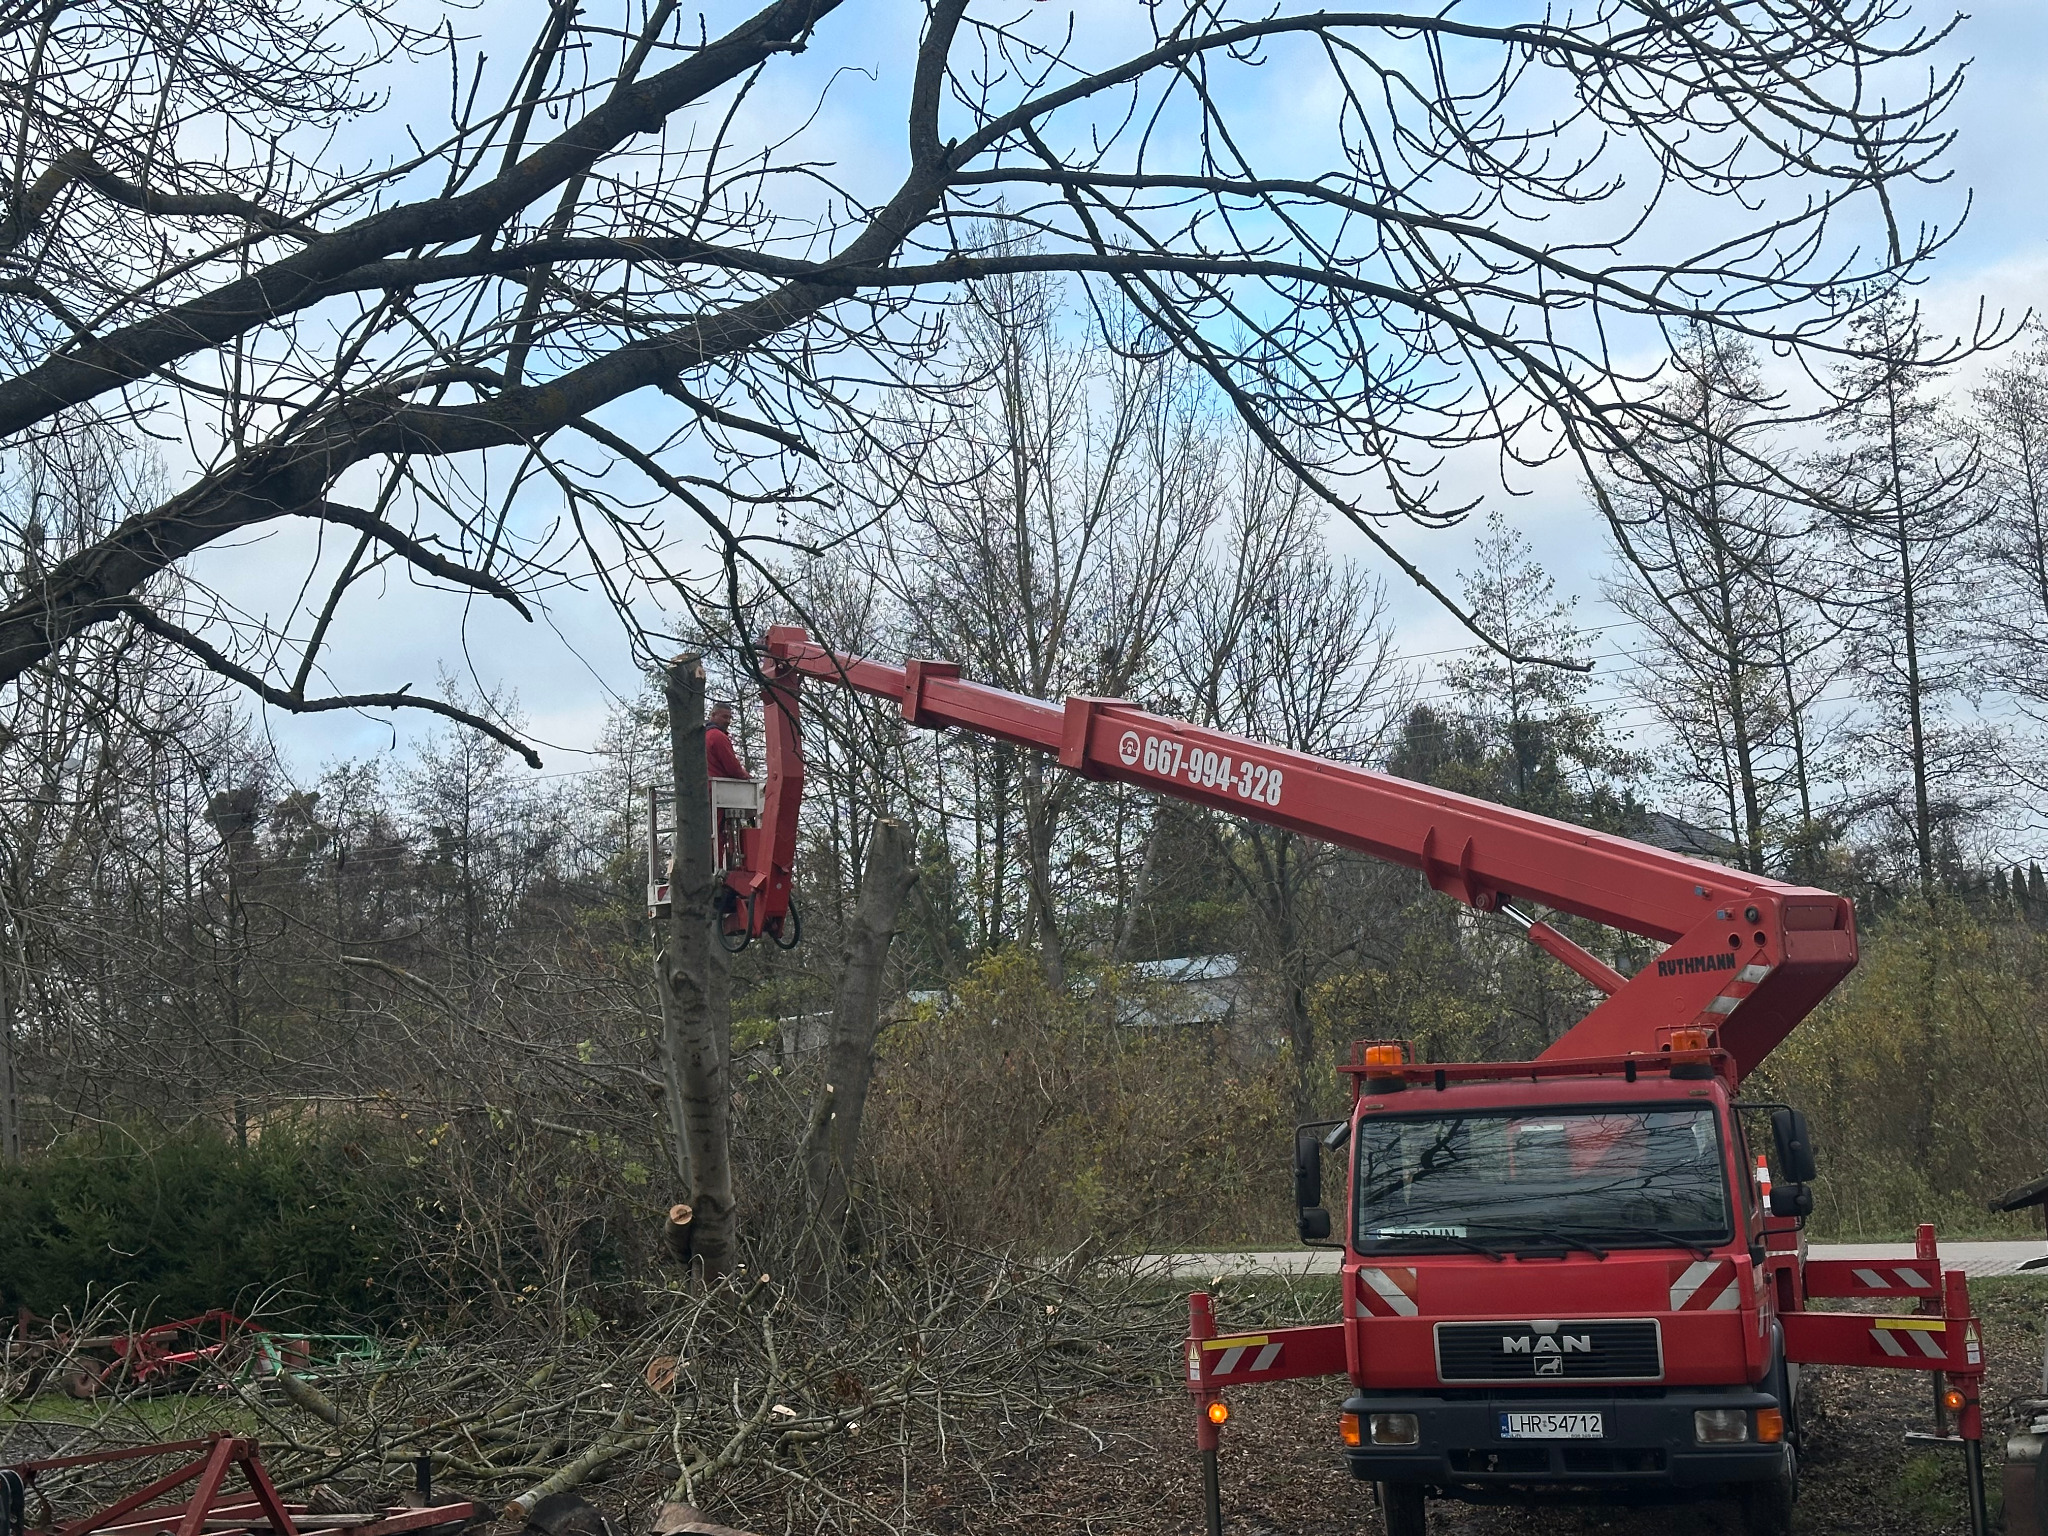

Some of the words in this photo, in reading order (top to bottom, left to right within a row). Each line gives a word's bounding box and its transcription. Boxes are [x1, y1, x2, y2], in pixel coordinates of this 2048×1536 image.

[1143, 736, 1283, 806] 667-994-328
[1658, 953, 1736, 977] RUTHMANN
[1502, 1335, 1591, 1353] MAN
